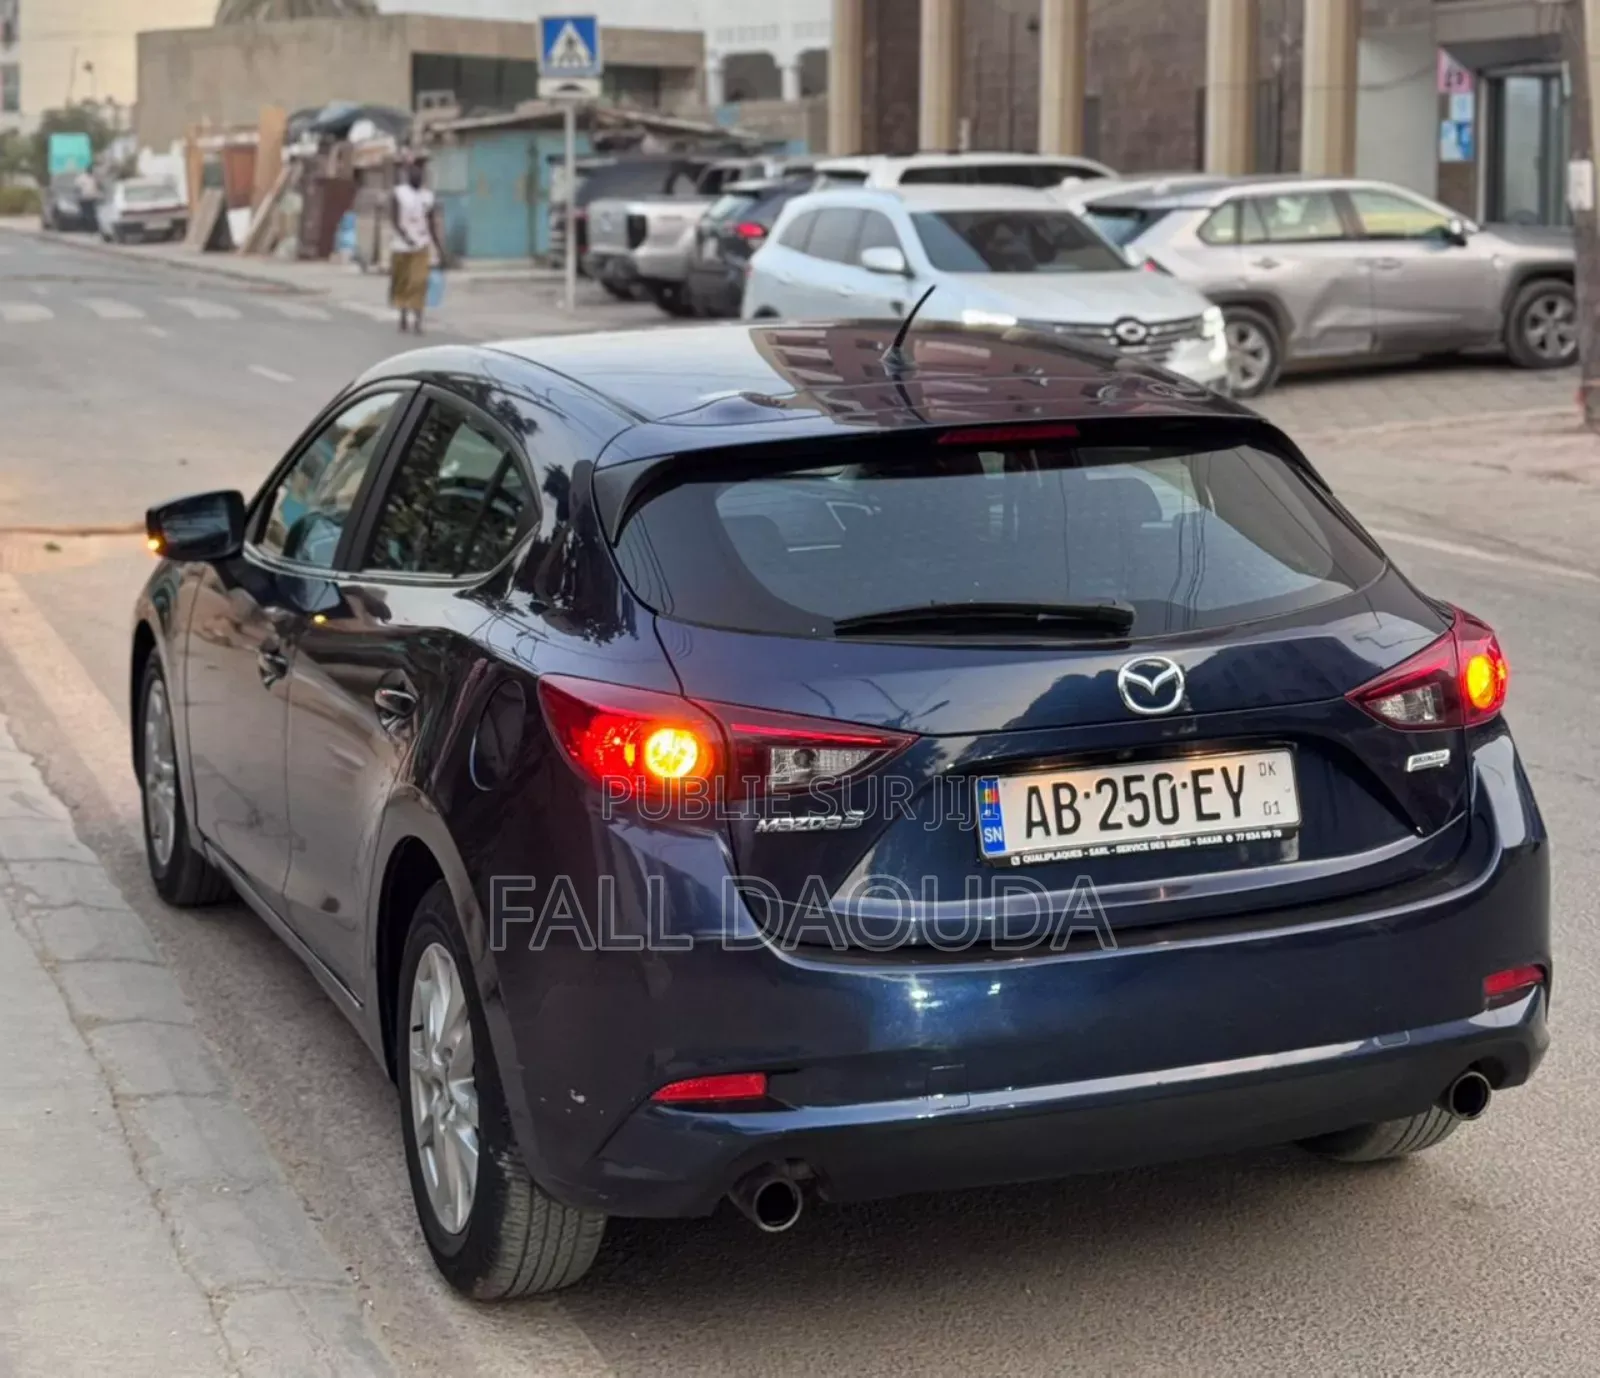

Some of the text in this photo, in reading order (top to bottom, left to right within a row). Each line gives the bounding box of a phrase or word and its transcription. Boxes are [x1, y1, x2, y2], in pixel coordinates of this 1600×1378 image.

[1258, 761, 1277, 777] DK
[1263, 800, 1281, 816] 01
[984, 826, 1003, 843] SN
[1115, 842, 1149, 854] SERVICE
